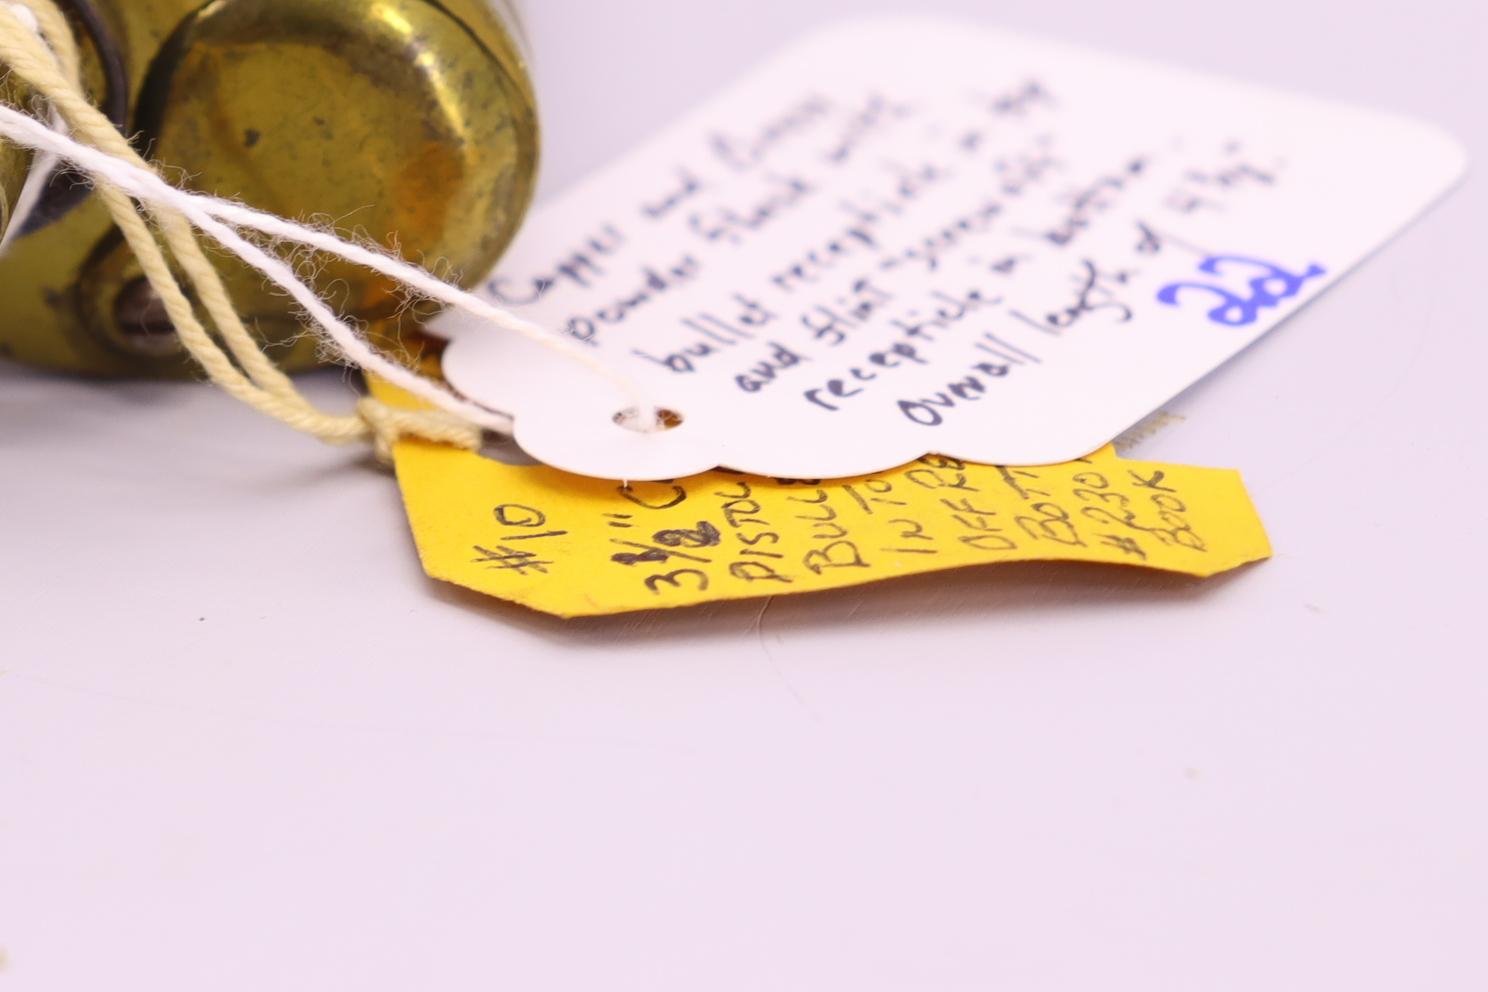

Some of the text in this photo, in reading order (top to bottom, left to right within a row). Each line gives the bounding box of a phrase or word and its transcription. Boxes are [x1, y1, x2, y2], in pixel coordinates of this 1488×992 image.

[1156, 253, 1328, 328] 22
[632, 291, 776, 373] bullet
[734, 340, 812, 394] and
[896, 331, 1043, 427] Overall
[471, 503, 568, 576] #10
[881, 517, 938, 555] IN
[940, 497, 1019, 551] OFF
[1128, 468, 1209, 553] BOOK
